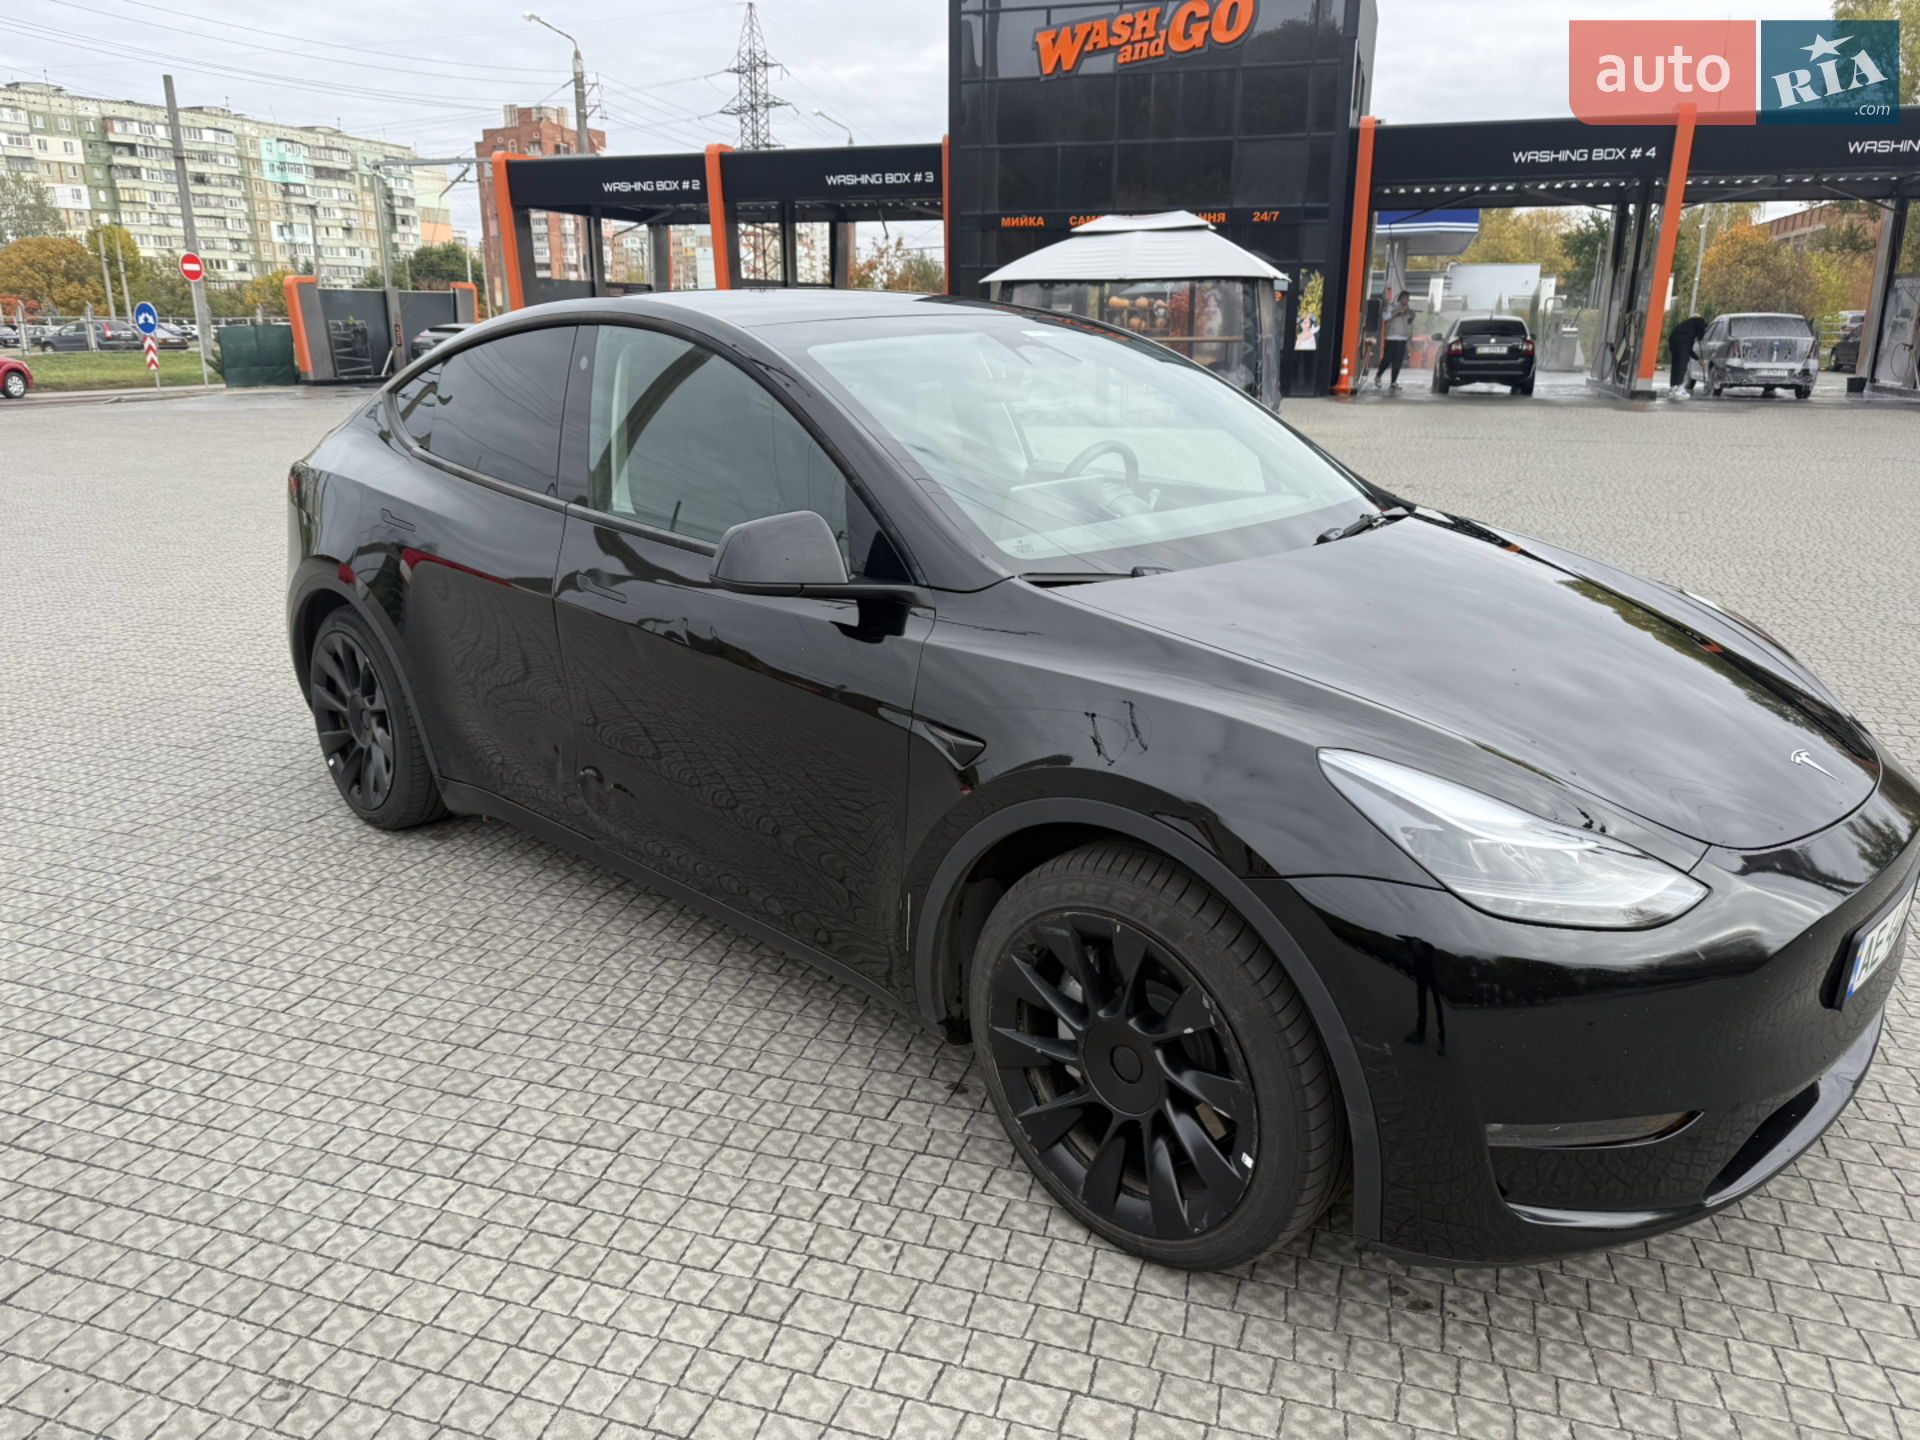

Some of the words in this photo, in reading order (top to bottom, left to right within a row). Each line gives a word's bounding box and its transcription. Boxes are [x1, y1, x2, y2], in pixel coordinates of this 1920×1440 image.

[1035, 7, 1161, 76] WASH
[1117, 29, 1167, 65] and
[1168, 0, 1255, 53] GO
[1512, 149, 1589, 164] WASHING
[1591, 147, 1627, 161] BOX
[1645, 146, 1657, 159] 4
[825, 174, 882, 185] WASHING
[884, 172, 911, 184] BOX
[924, 171, 935, 183] 3
[602, 182, 654, 192] WASHING
[656, 180, 679, 191] BOX
[691, 179, 701, 190] 2
[1001, 215, 1045, 228] МИЙКА
[1252, 211, 1280, 223] 24/7
